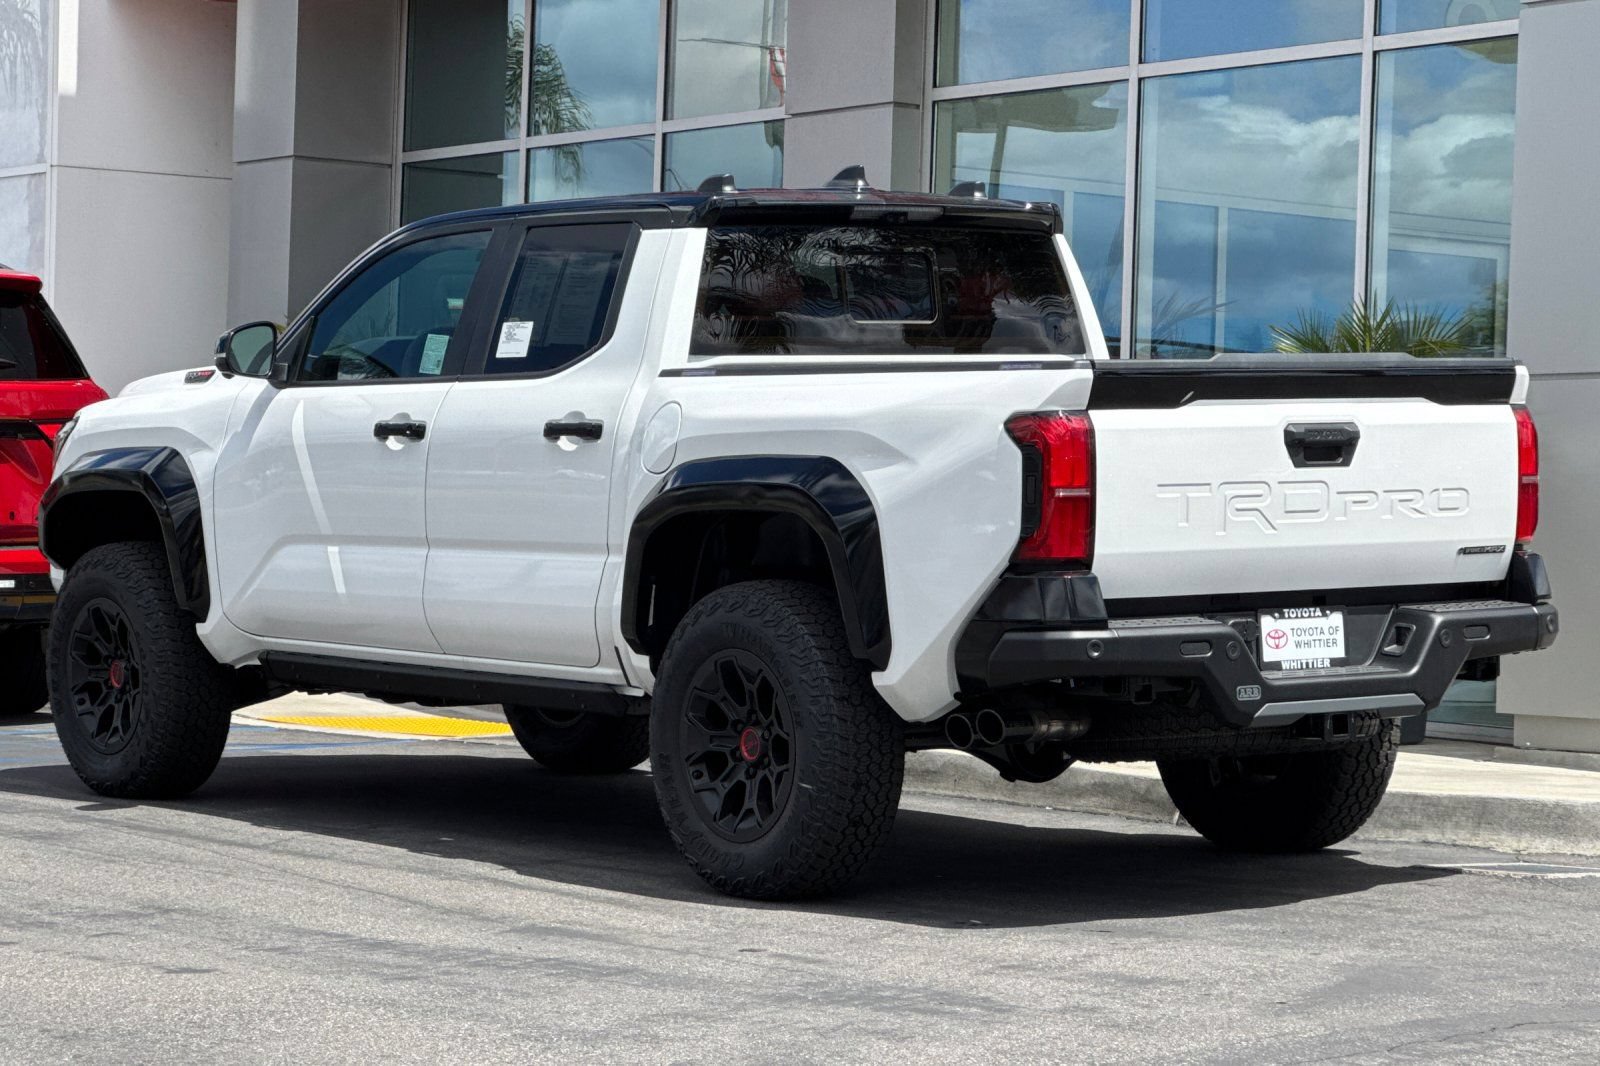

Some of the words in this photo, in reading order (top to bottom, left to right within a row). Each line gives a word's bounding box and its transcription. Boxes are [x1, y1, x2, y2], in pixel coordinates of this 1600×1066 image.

[1156, 480, 1329, 536] TRD
[1335, 487, 1470, 520] PRO
[1283, 607, 1322, 618] TOYOTA
[1290, 627, 1325, 637] TOYOTA
[1328, 626, 1340, 636] OF
[1294, 638, 1338, 649] WHITTIER
[1281, 658, 1331, 670] WHITTIER
[1239, 687, 1259, 698] ARB
